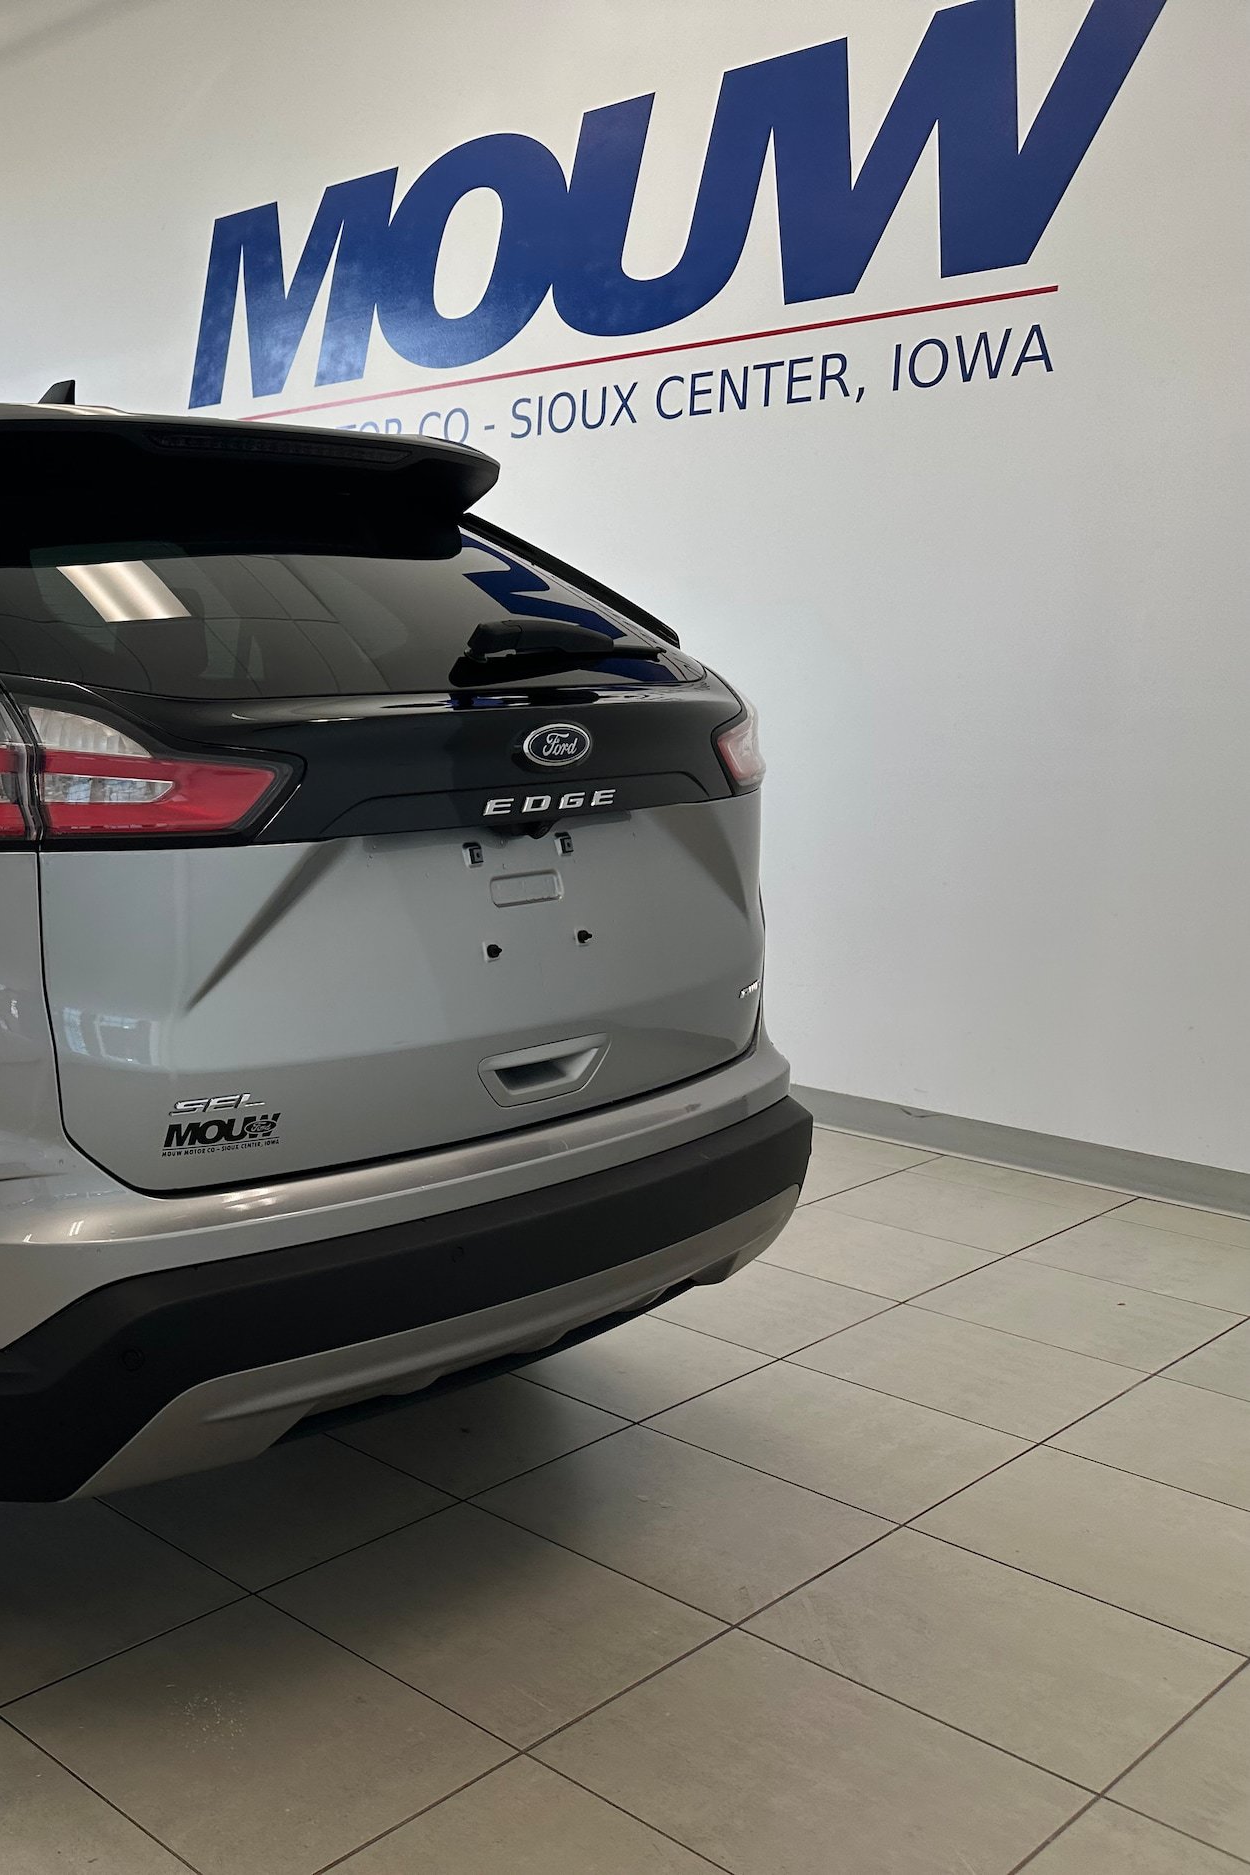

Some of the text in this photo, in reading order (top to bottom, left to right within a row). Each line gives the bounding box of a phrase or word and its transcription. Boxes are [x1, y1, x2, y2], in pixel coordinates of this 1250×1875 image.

[188, 0, 1167, 410] MOUW
[510, 381, 638, 438] SIOUX
[655, 352, 867, 420] CENTER,
[892, 323, 1055, 392] IOWA
[542, 732, 578, 756] Ford
[483, 789, 616, 816] EDGE
[169, 1093, 266, 1116] SEL
